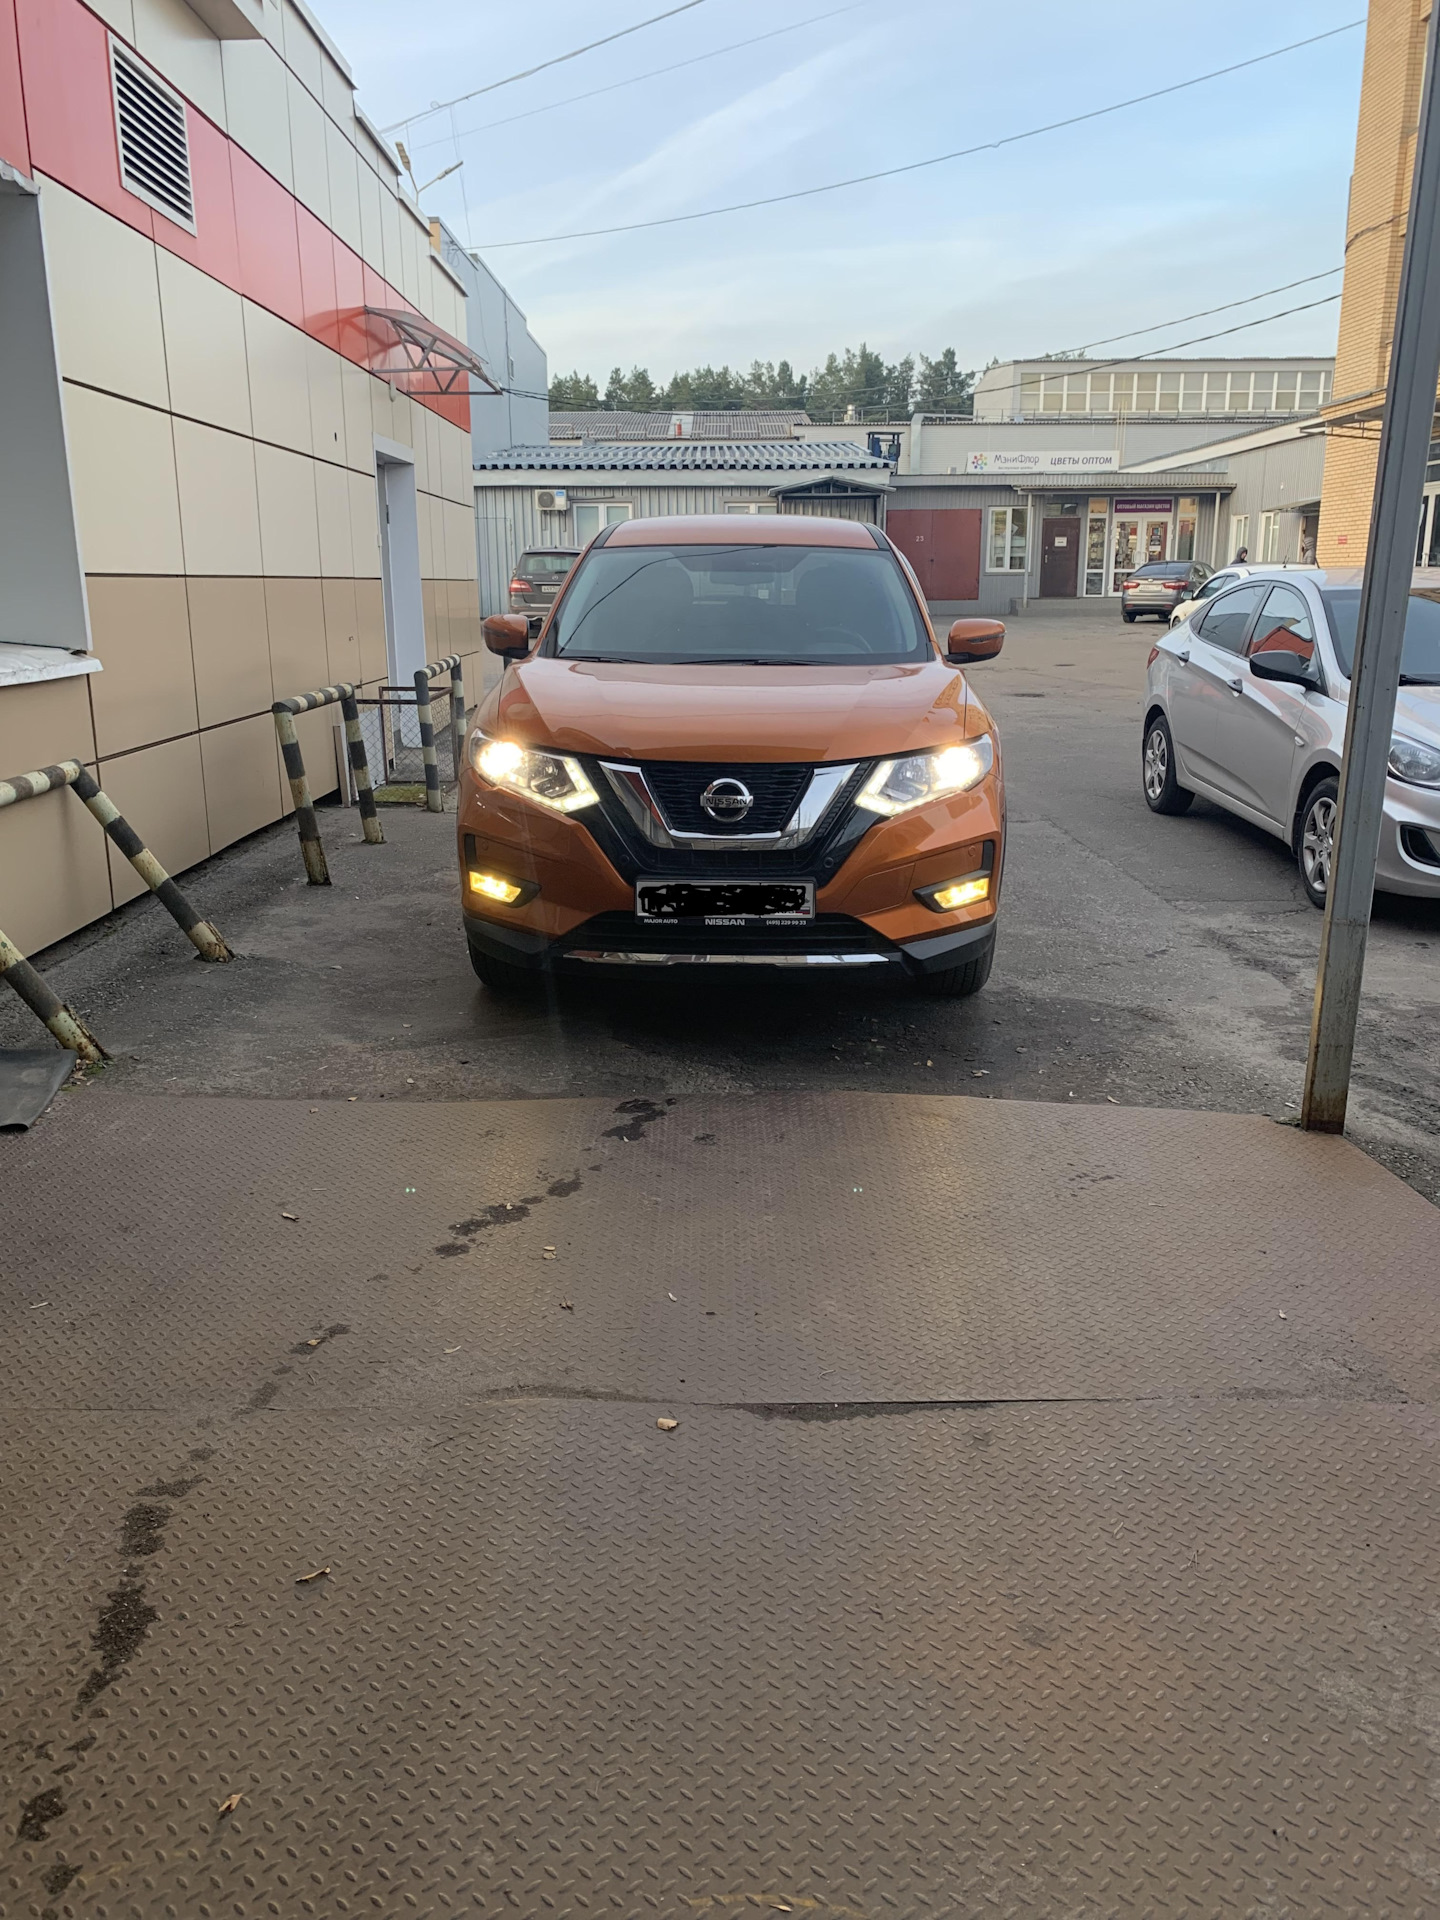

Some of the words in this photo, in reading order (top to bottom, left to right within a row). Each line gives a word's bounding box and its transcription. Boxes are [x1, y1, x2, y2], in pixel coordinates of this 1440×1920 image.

[994, 454, 1040, 466] МэниФлор
[1050, 457, 1080, 466] ЦВЕТЫ
[1081, 456, 1112, 465] ОПТОМ
[705, 918, 745, 926] NISSAN
